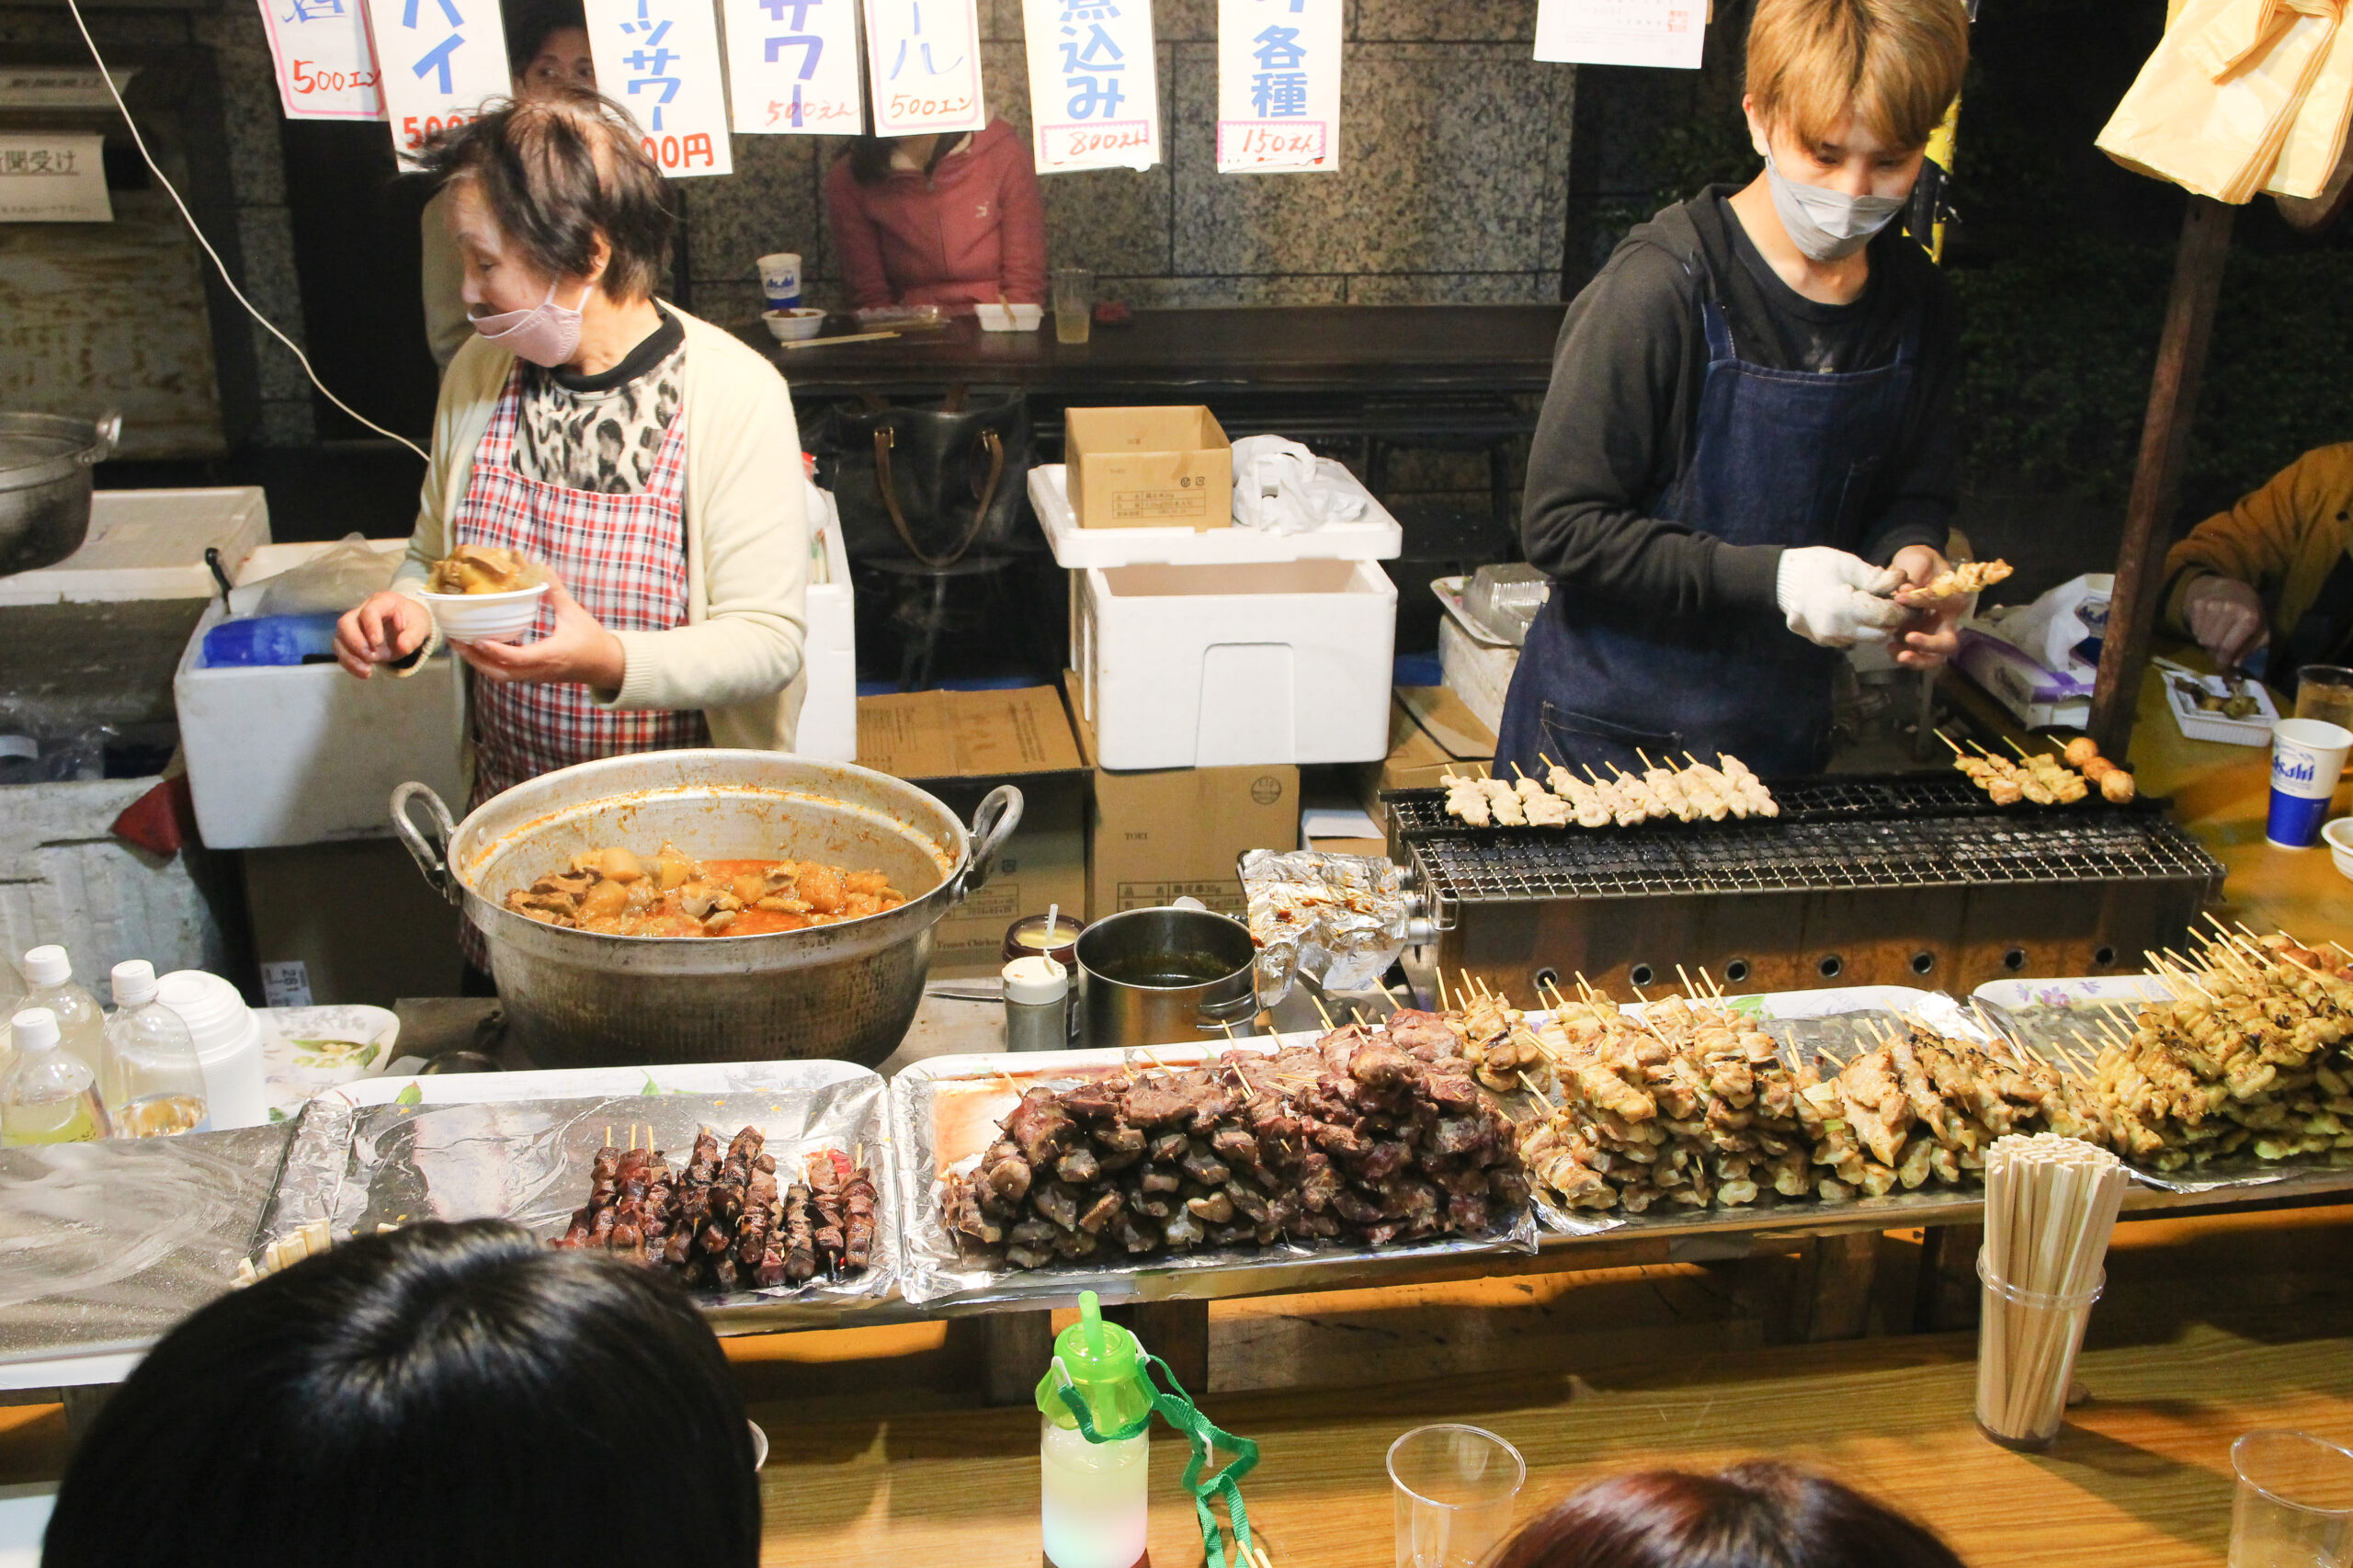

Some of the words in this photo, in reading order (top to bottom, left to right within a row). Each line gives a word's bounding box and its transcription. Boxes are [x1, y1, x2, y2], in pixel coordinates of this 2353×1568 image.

[760, 0, 824, 128] サワー
[1251, 0, 1308, 118] 各種
[0, 150, 76, 174] 聞受け
[641, 132, 715, 168] 00円
